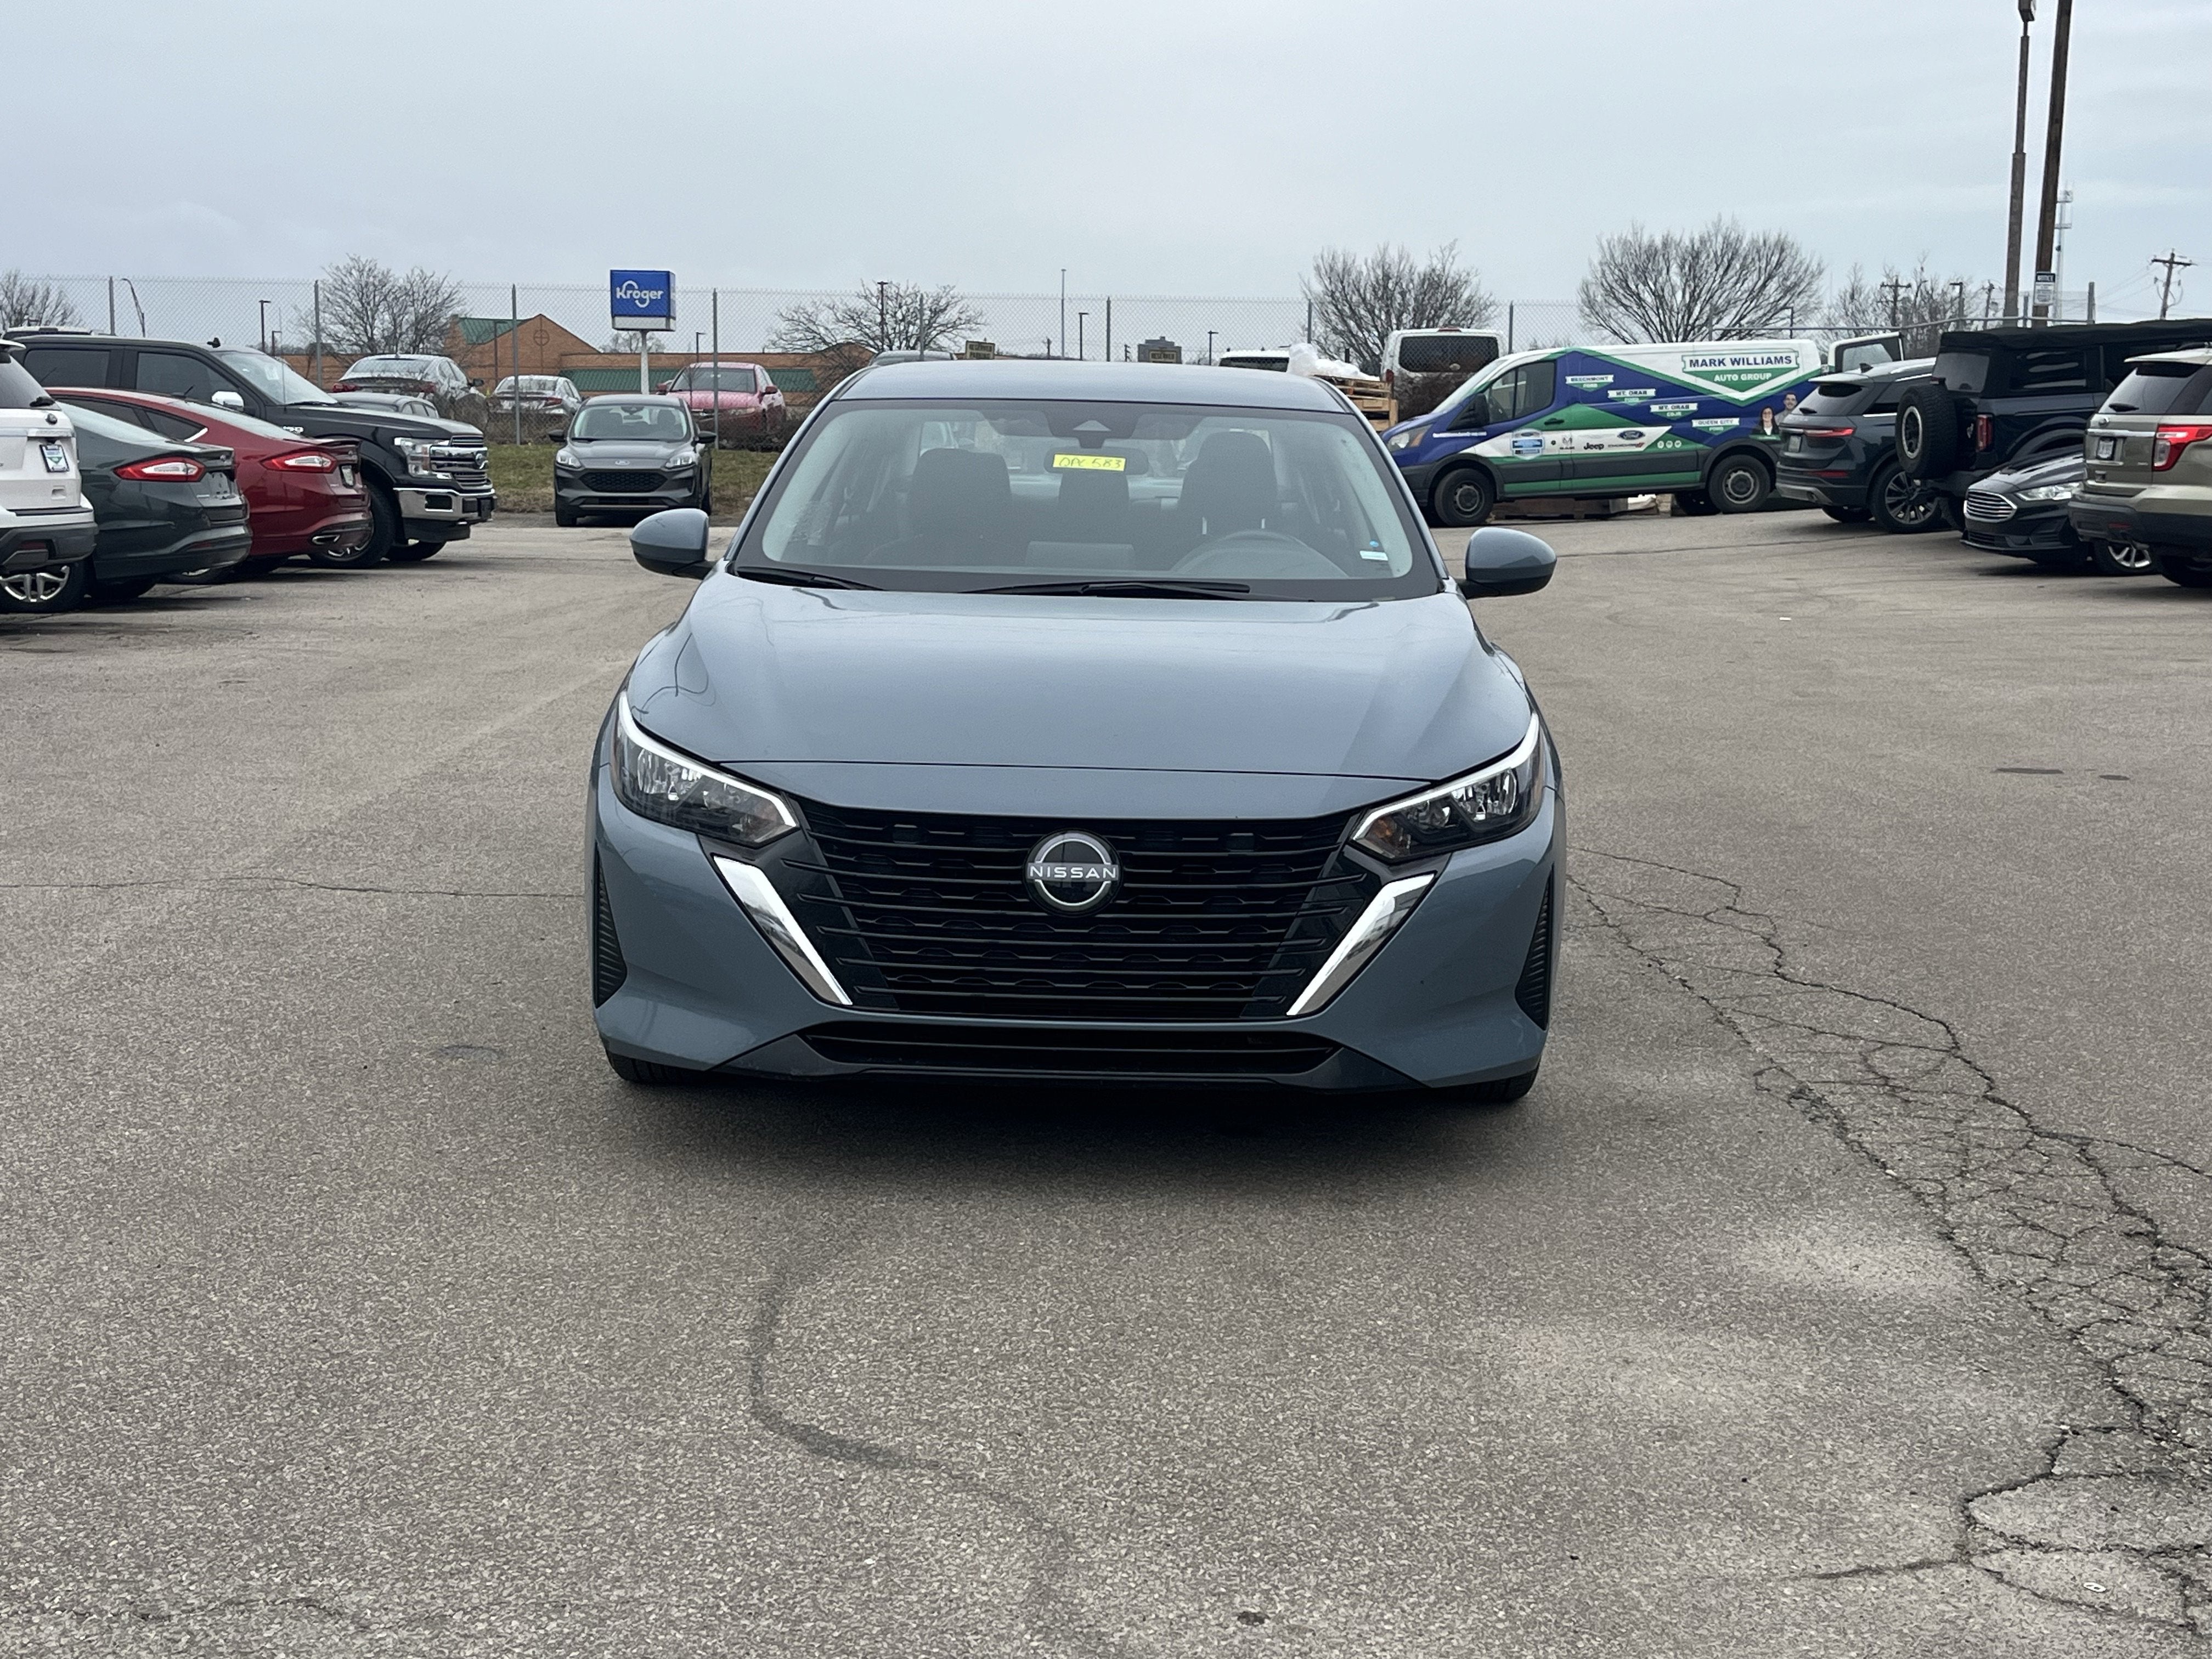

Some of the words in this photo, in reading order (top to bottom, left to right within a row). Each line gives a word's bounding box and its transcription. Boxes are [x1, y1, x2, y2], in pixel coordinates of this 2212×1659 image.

[616, 280, 664, 308] Kroger
[1690, 358, 1726, 368] MARK
[1729, 356, 1792, 366] WILLIAMS
[1713, 374, 1739, 382] AUTO
[1740, 373, 1772, 381] GROUP
[1584, 442, 1605, 450] Jeep
[1030, 865, 1116, 878] NISSAN
